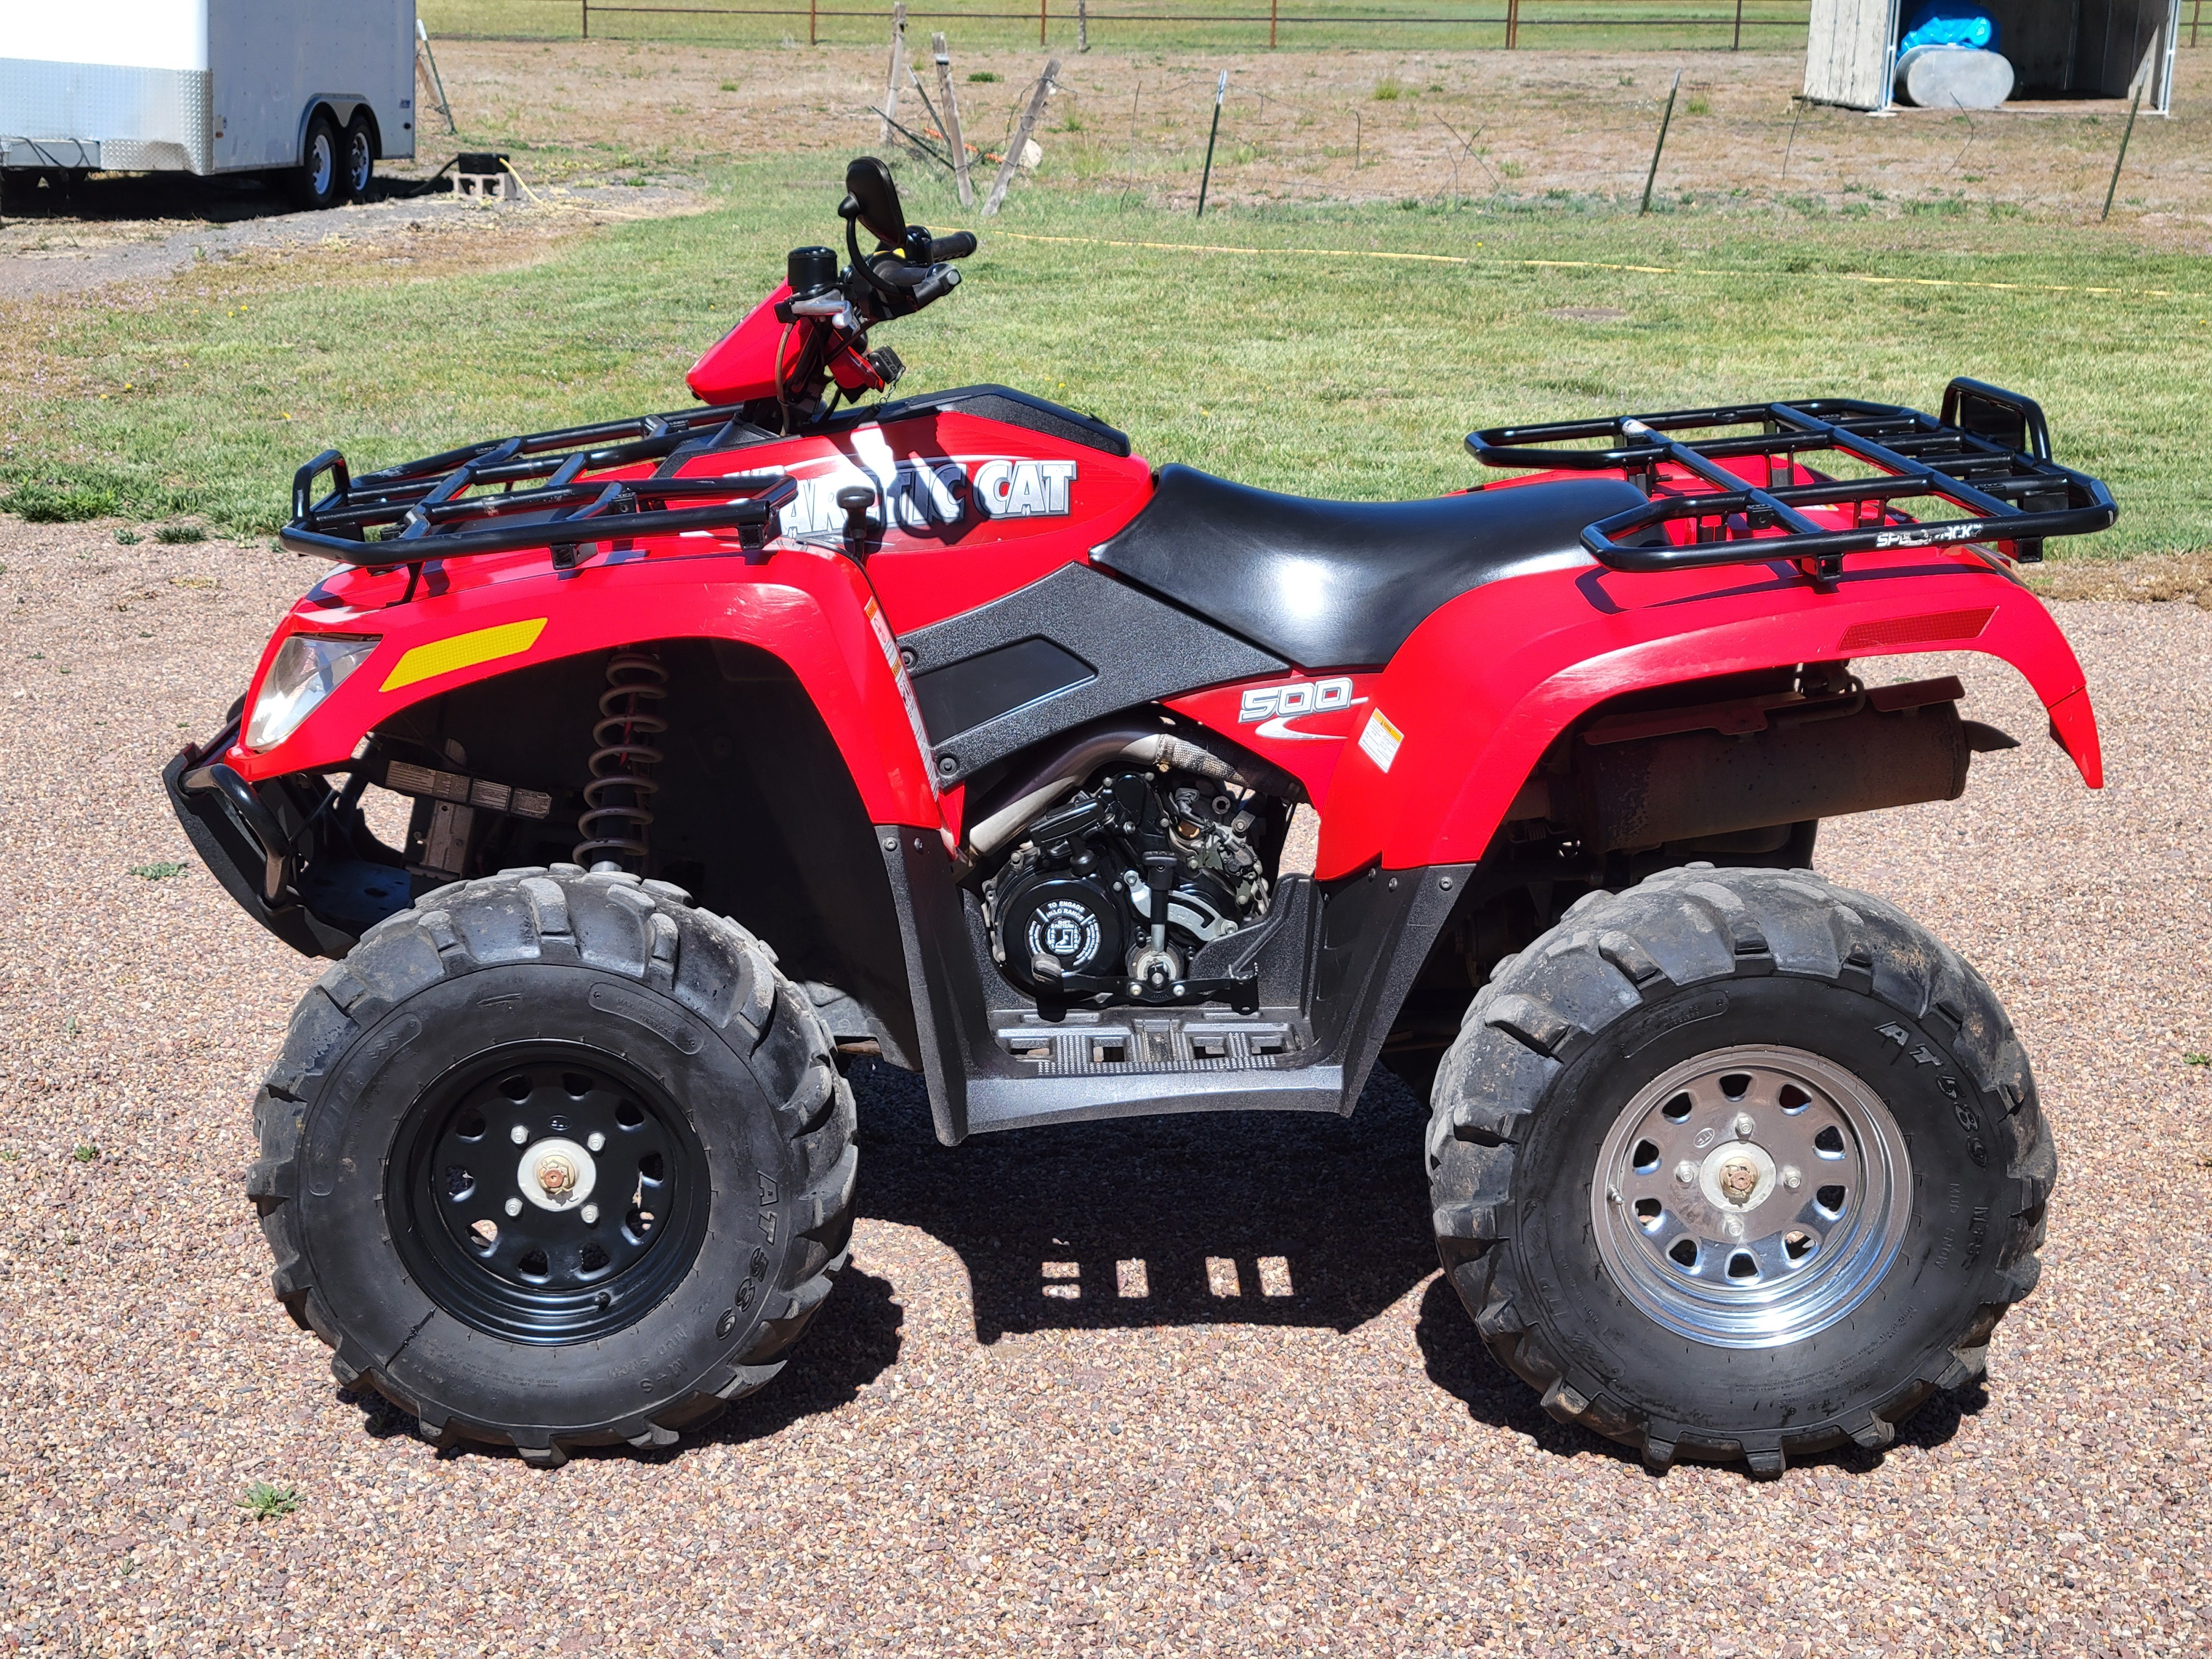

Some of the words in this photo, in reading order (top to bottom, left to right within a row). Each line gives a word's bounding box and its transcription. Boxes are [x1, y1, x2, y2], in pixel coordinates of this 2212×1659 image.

[777, 462, 967, 540] ARTIC
[973, 460, 1077, 519] CAT
[1238, 677, 1354, 724] 500
[1059, 901, 1085, 912] ENGAGE
[1063, 909, 1085, 921] RANGE
[1948, 1182, 1961, 1215] MUD
[1933, 1226, 1956, 1271] SNOW
[657, 1324, 687, 1357] MUD
